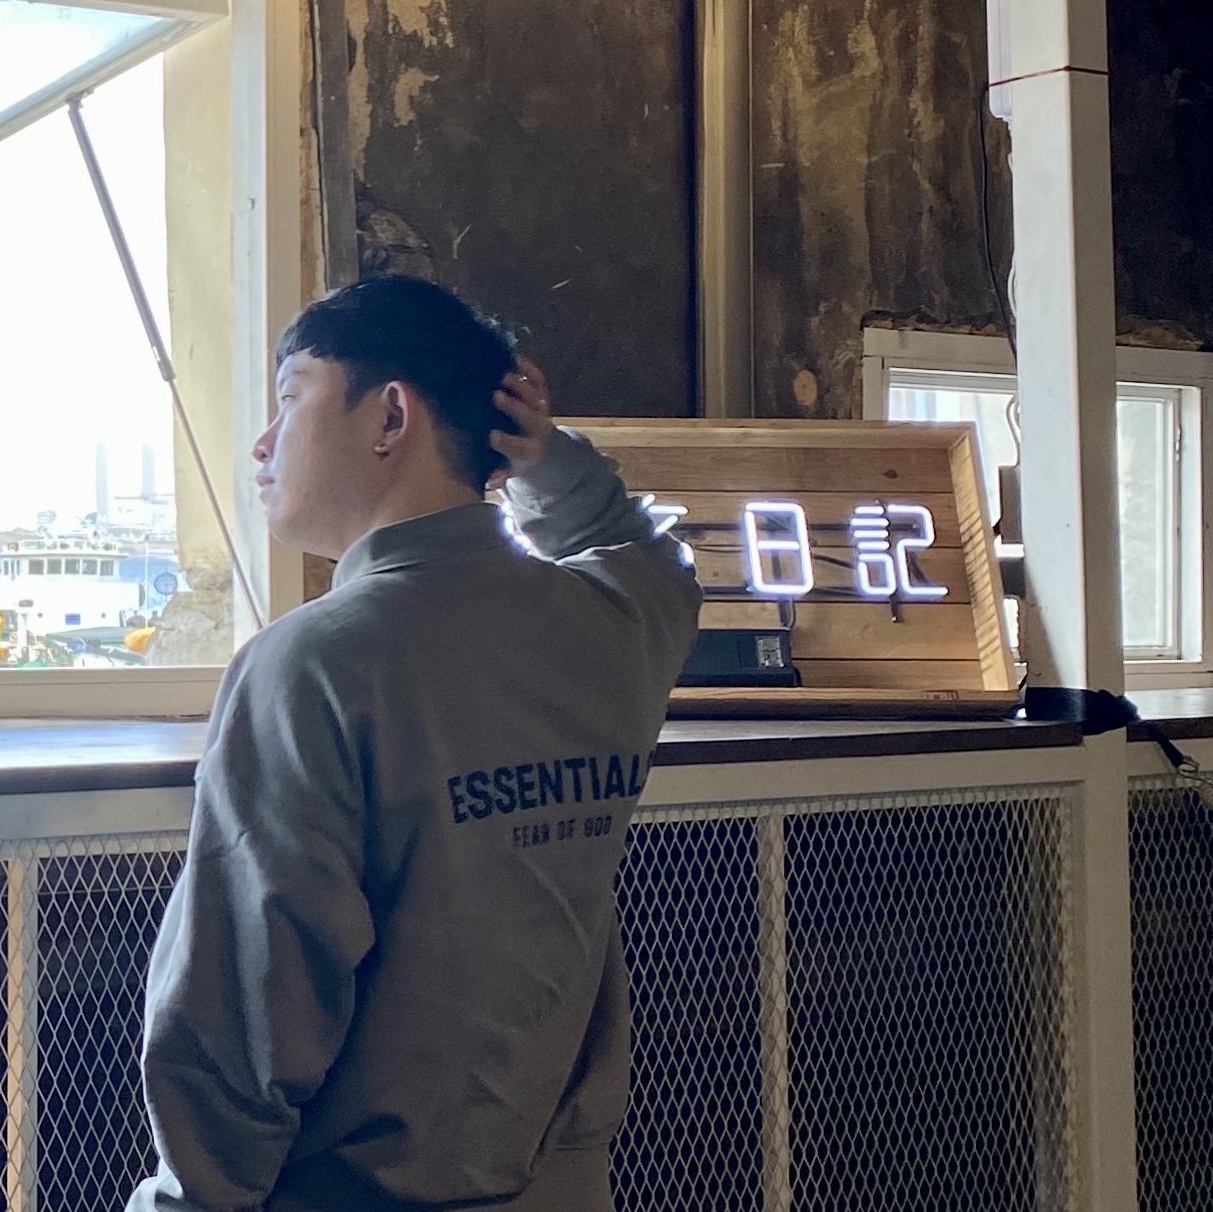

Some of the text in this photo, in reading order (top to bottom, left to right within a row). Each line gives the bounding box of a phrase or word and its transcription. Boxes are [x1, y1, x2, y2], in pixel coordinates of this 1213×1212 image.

[447, 754, 653, 824] ESSENTIAL
[512, 815, 612, 849] FEAR OF GOD
